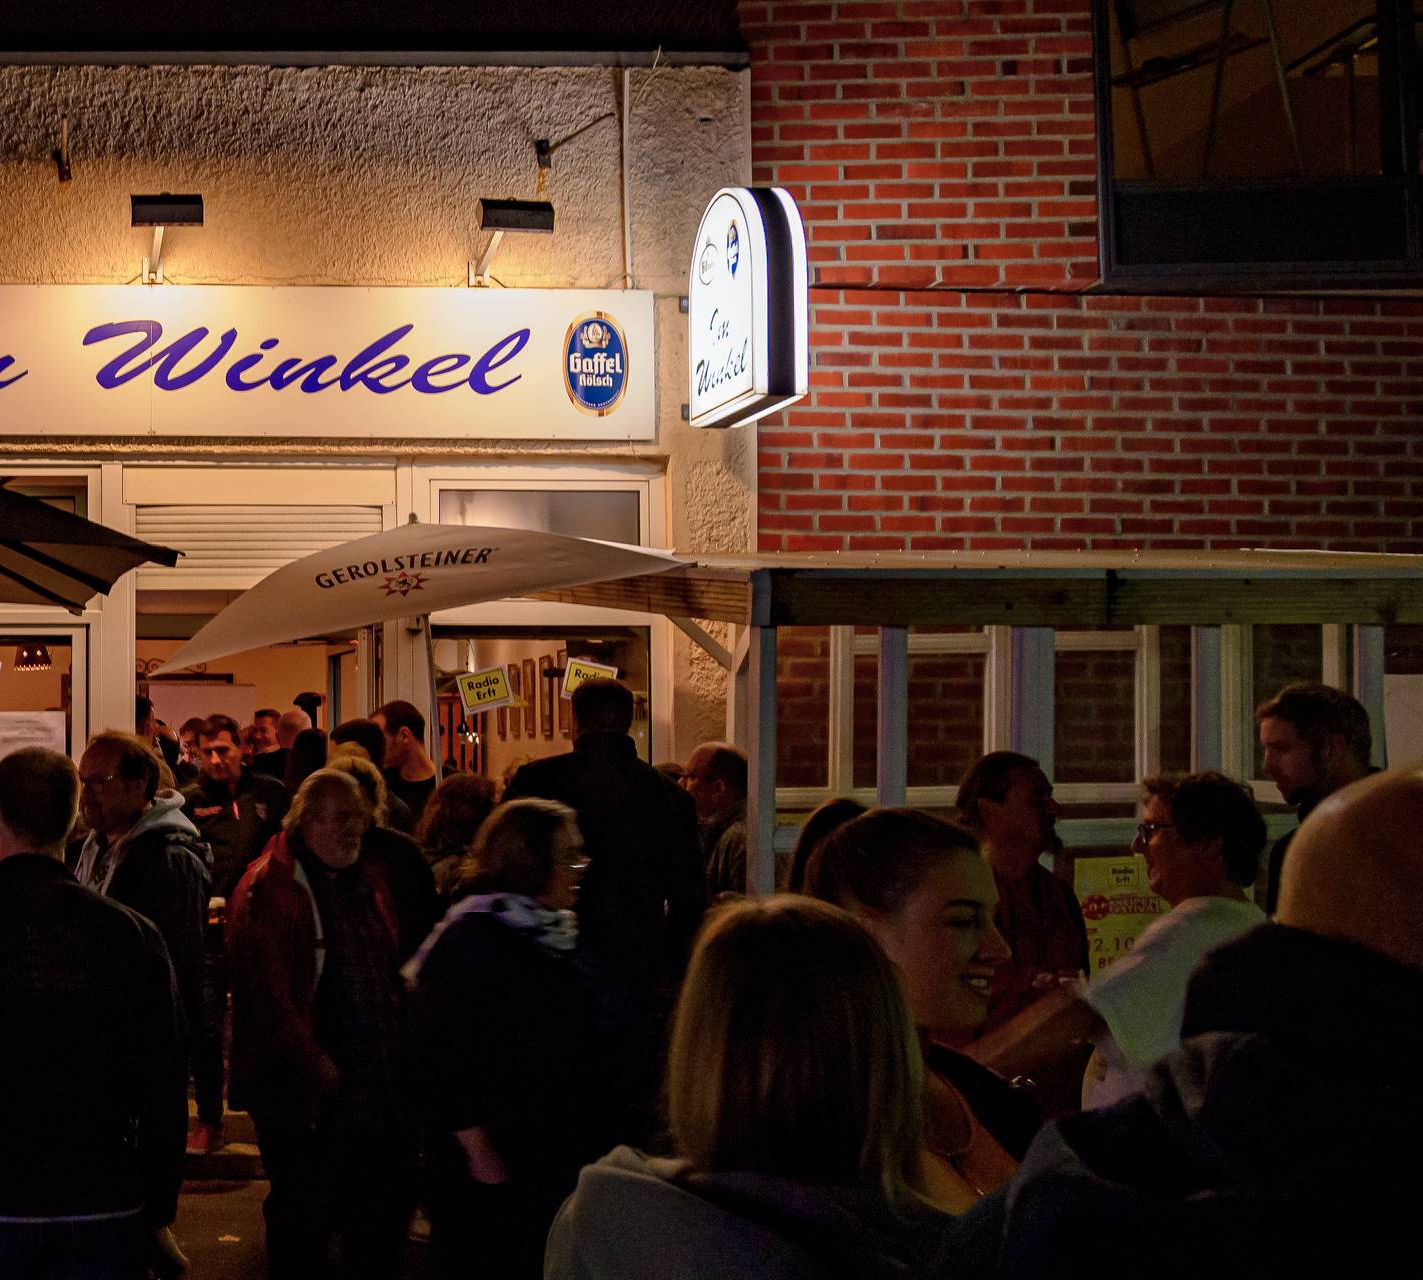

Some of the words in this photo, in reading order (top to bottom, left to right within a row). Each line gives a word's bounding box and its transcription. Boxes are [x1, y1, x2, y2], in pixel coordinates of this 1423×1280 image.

[82, 319, 531, 395] Winkel
[569, 352, 623, 375] Gaffel
[695, 337, 748, 397] Winkel
[579, 373, 613, 387] Kölsch
[315, 547, 493, 589] GEROLSTEINER
[467, 676, 500, 691] Radio
[573, 669, 605, 680] Radi
[476, 688, 497, 701] Erft
